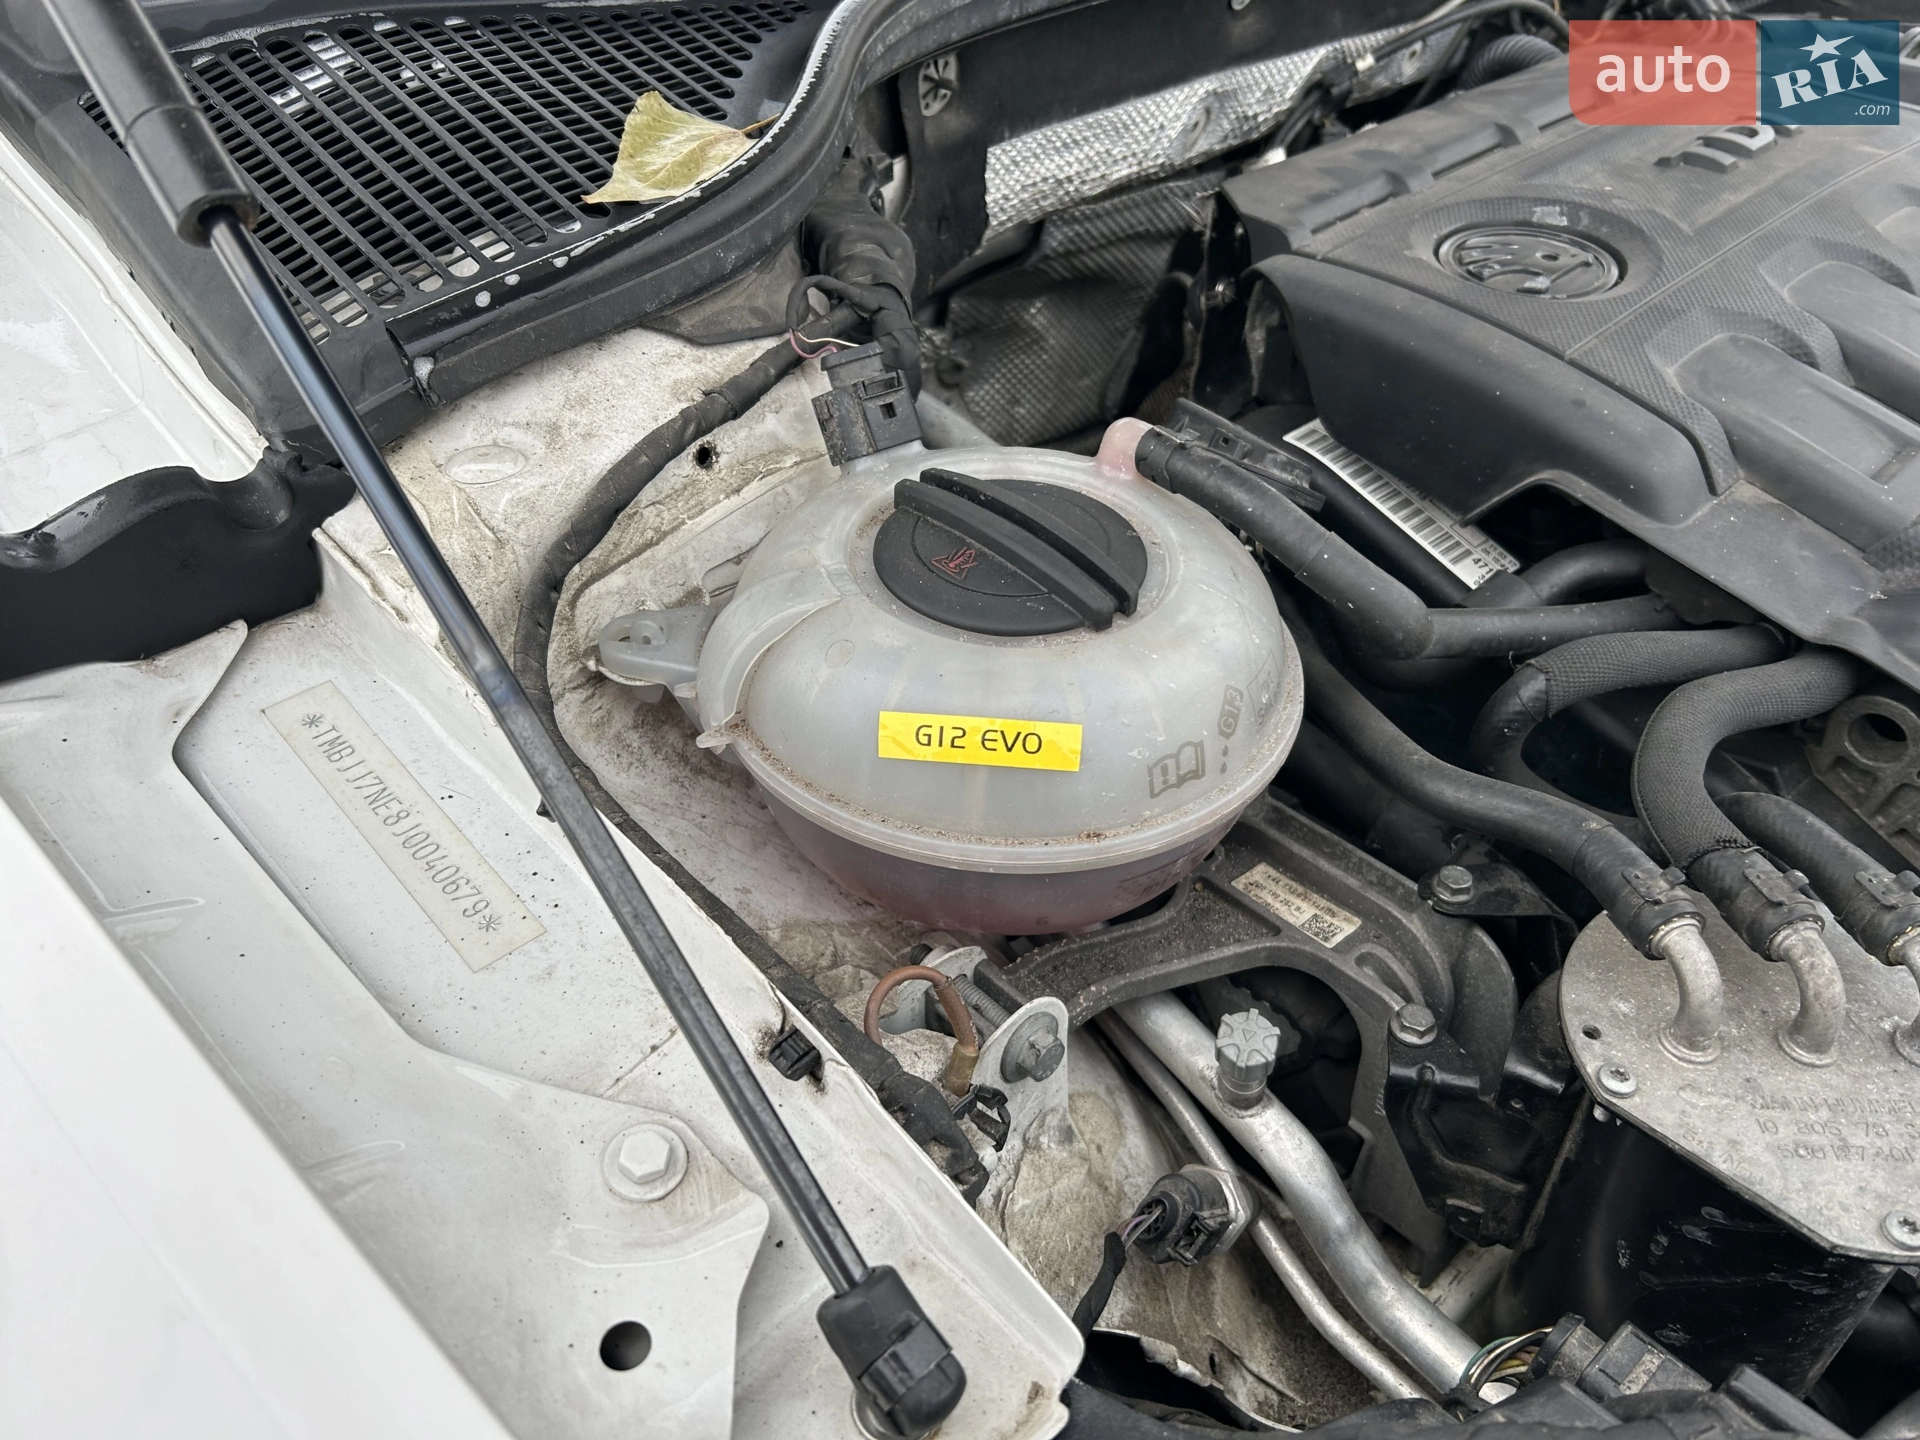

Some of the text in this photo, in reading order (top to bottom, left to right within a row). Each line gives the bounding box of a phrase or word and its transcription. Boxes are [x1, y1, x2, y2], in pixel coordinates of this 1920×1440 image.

[1220, 689, 1242, 733] G13
[915, 724, 1043, 755] G12 EVO
